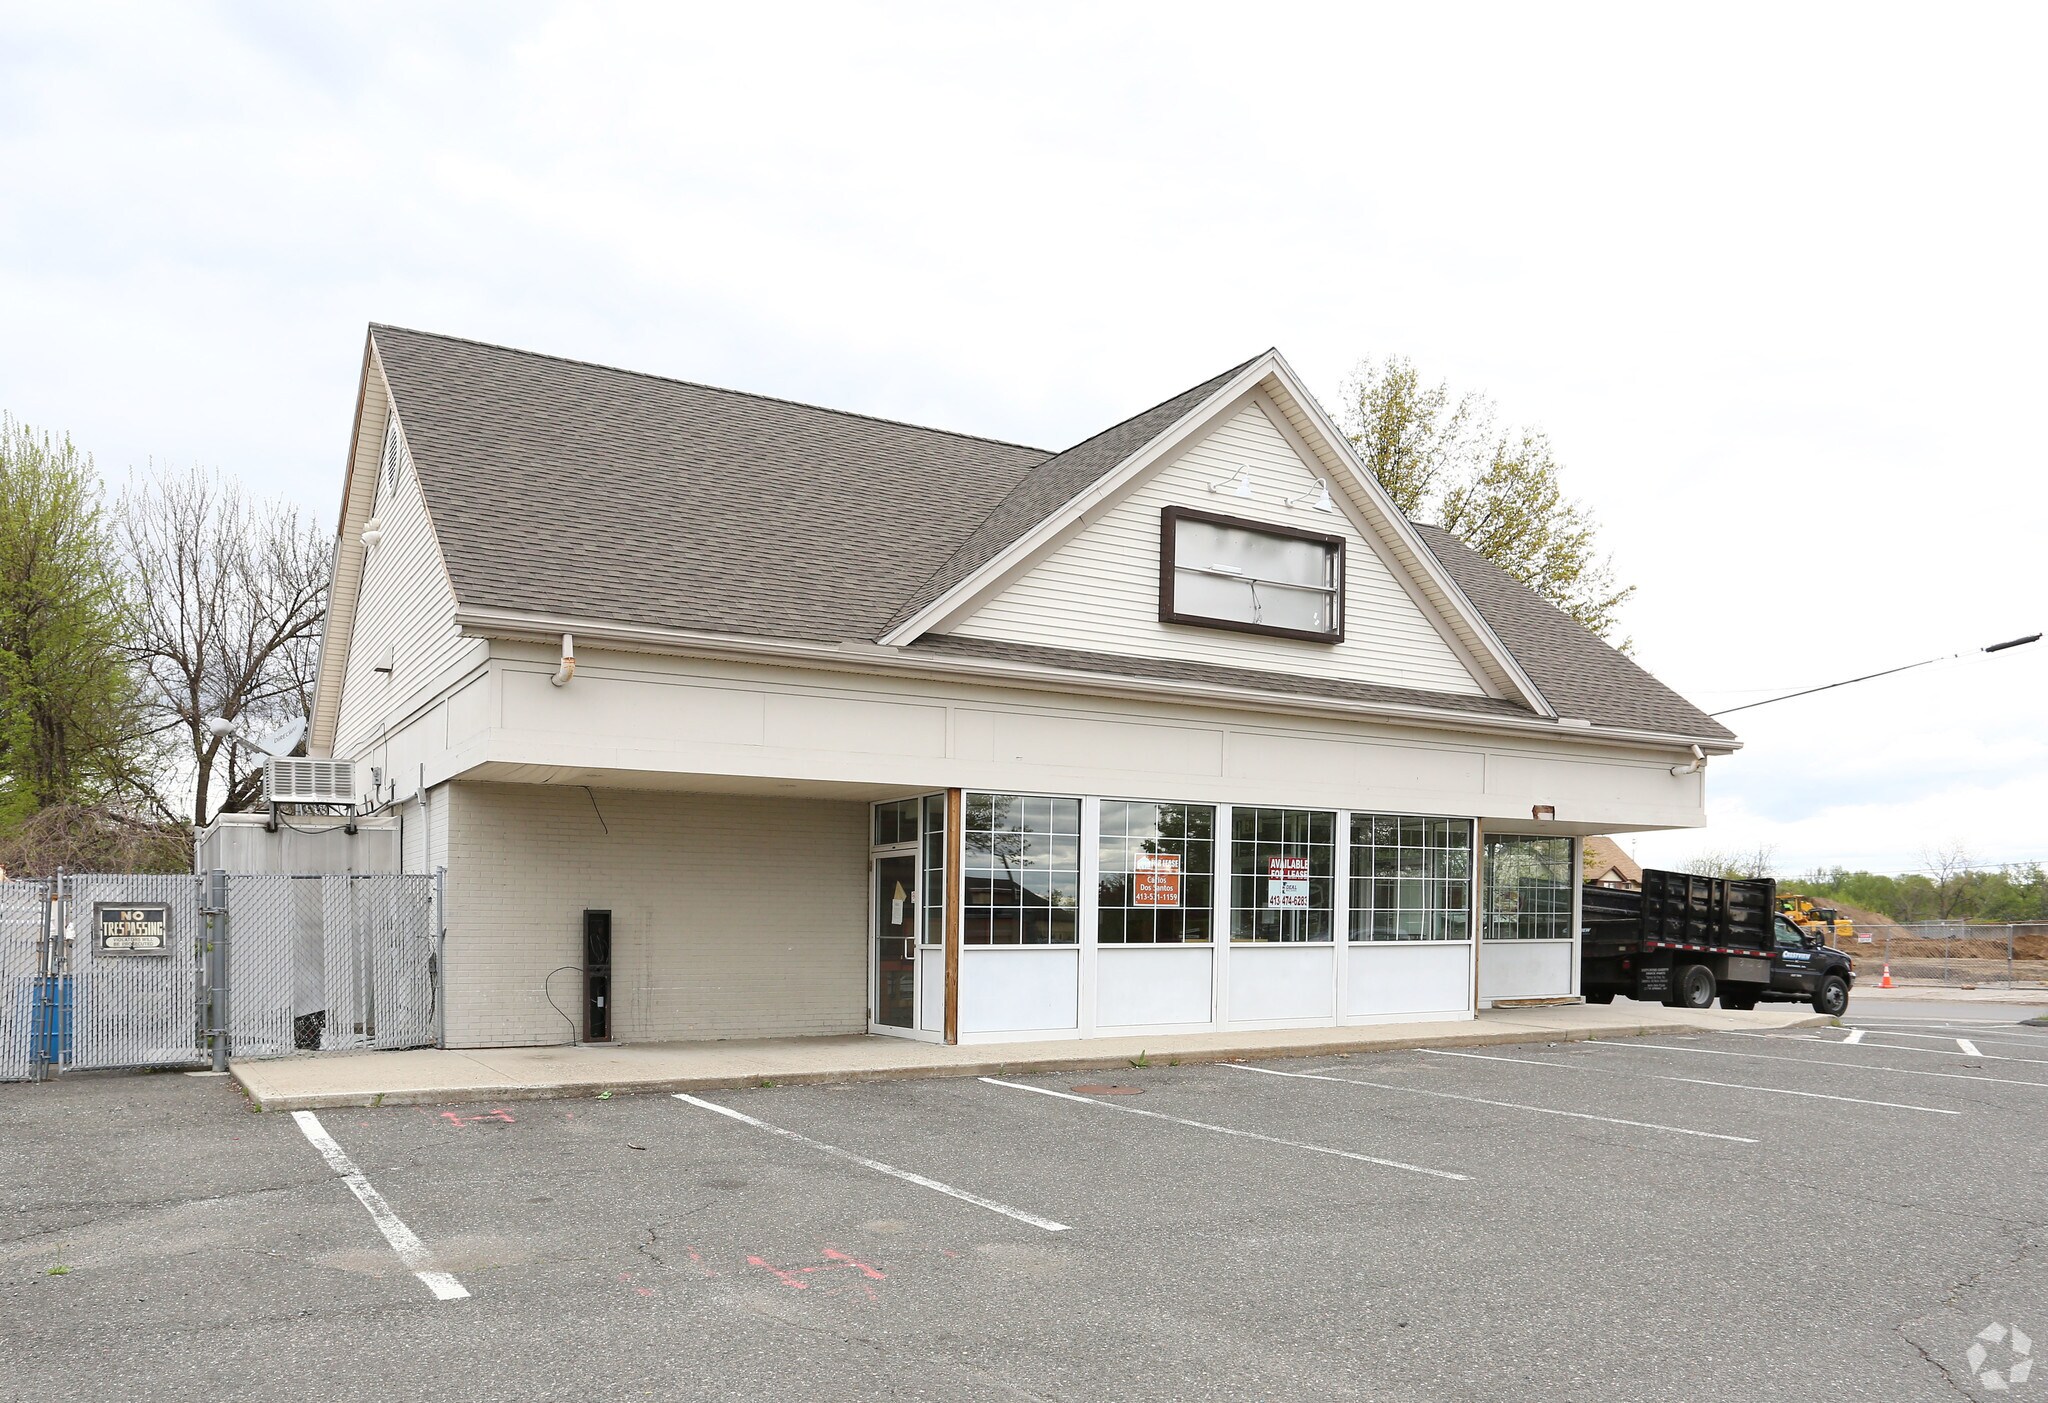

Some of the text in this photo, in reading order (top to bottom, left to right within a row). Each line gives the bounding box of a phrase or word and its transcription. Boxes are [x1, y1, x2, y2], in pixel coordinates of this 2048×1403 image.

[1270, 859, 1308, 869] AVAILABLE
[1271, 870, 1308, 880] FO LEASE
[121, 911, 144, 921] NO
[103, 921, 163, 936] TRESPASSING
